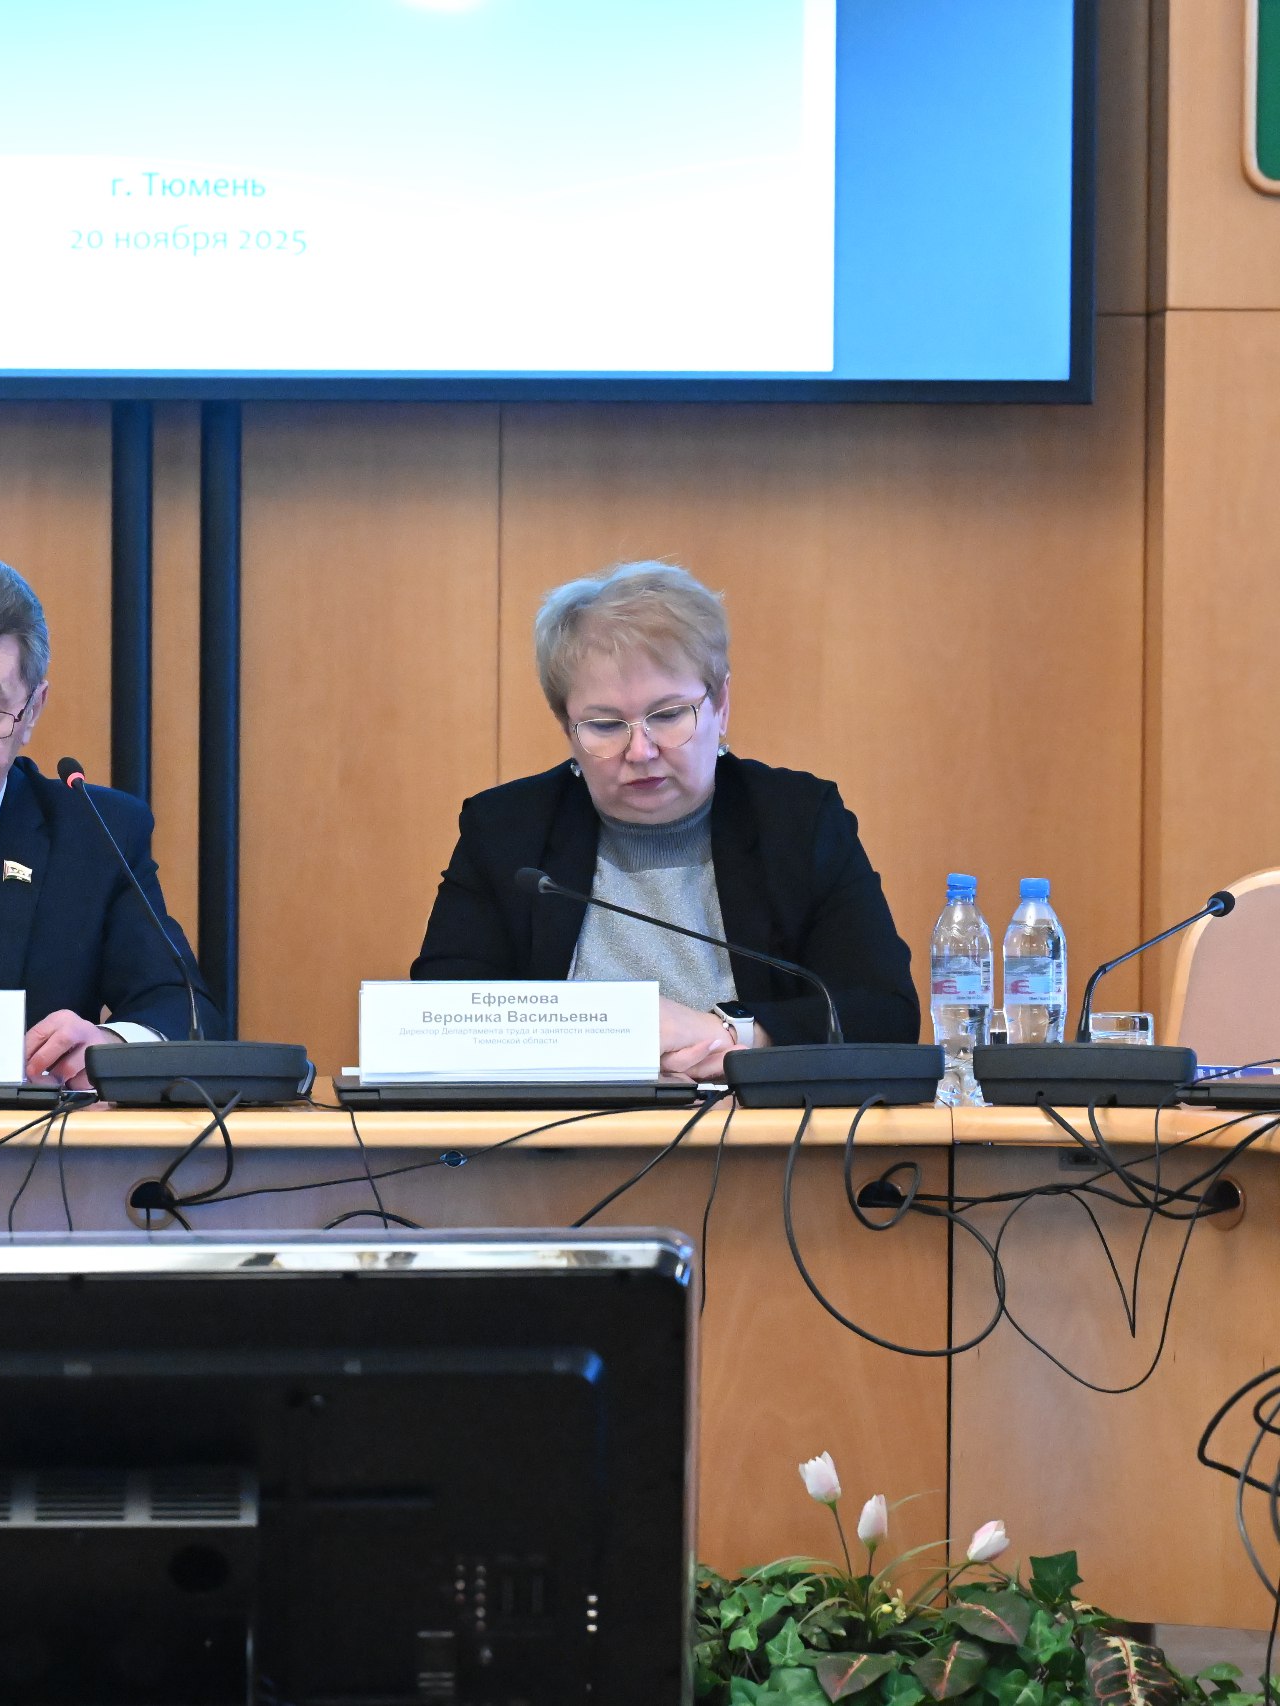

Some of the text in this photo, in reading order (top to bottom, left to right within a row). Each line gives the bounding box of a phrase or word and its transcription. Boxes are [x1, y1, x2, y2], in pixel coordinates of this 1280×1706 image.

[111, 172, 267, 198] г. Тюмень
[70, 224, 307, 256] 20 ноября 2025
[471, 992, 559, 1007] Ефремова
[422, 1010, 608, 1026] Вероника Васильевна
[399, 1028, 440, 1036] Директор
[441, 1028, 503, 1036] Департамента
[506, 1028, 530, 1037] труда
[473, 1037, 558, 1045] Тюменской области
